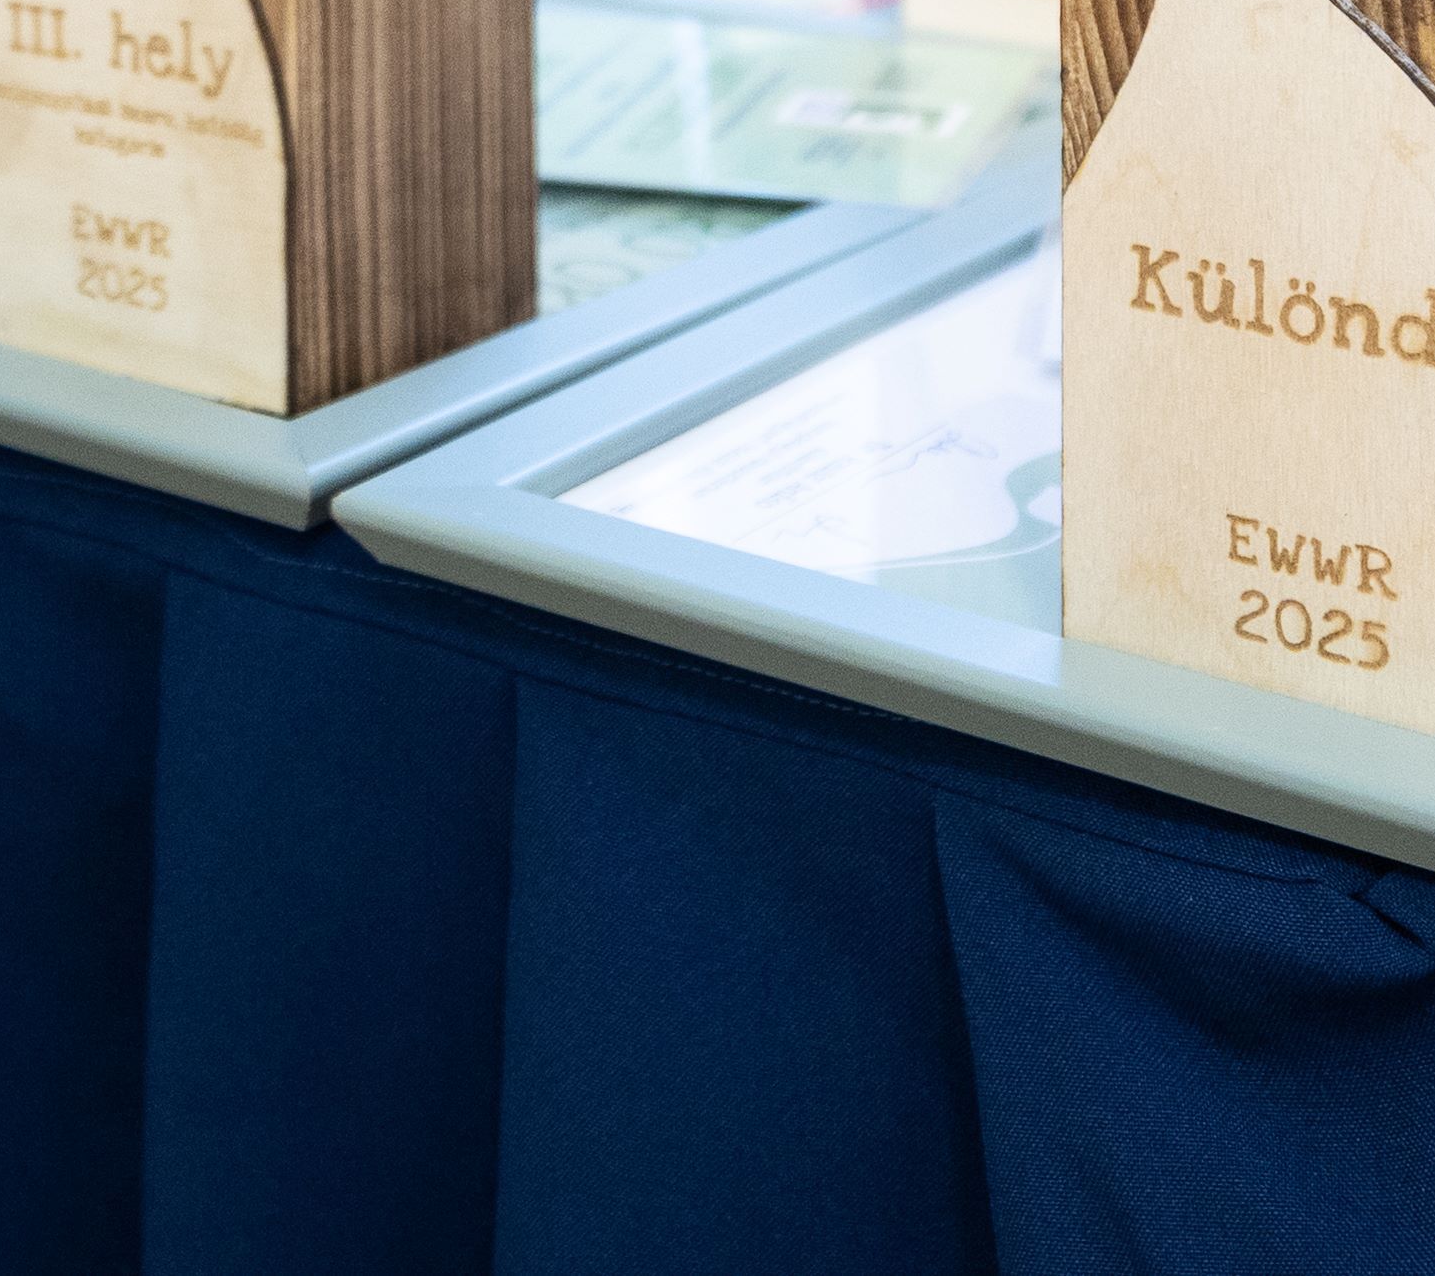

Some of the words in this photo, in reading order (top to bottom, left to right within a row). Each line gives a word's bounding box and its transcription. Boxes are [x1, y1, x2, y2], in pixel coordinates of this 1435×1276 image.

[6, 0, 83, 61] III.
[109, 8, 234, 99] hely
[70, 200, 172, 259] EWWR
[76, 255, 169, 313] 2025
[1226, 512, 1399, 601] EWWR
[1234, 588, 1391, 671] 2025
